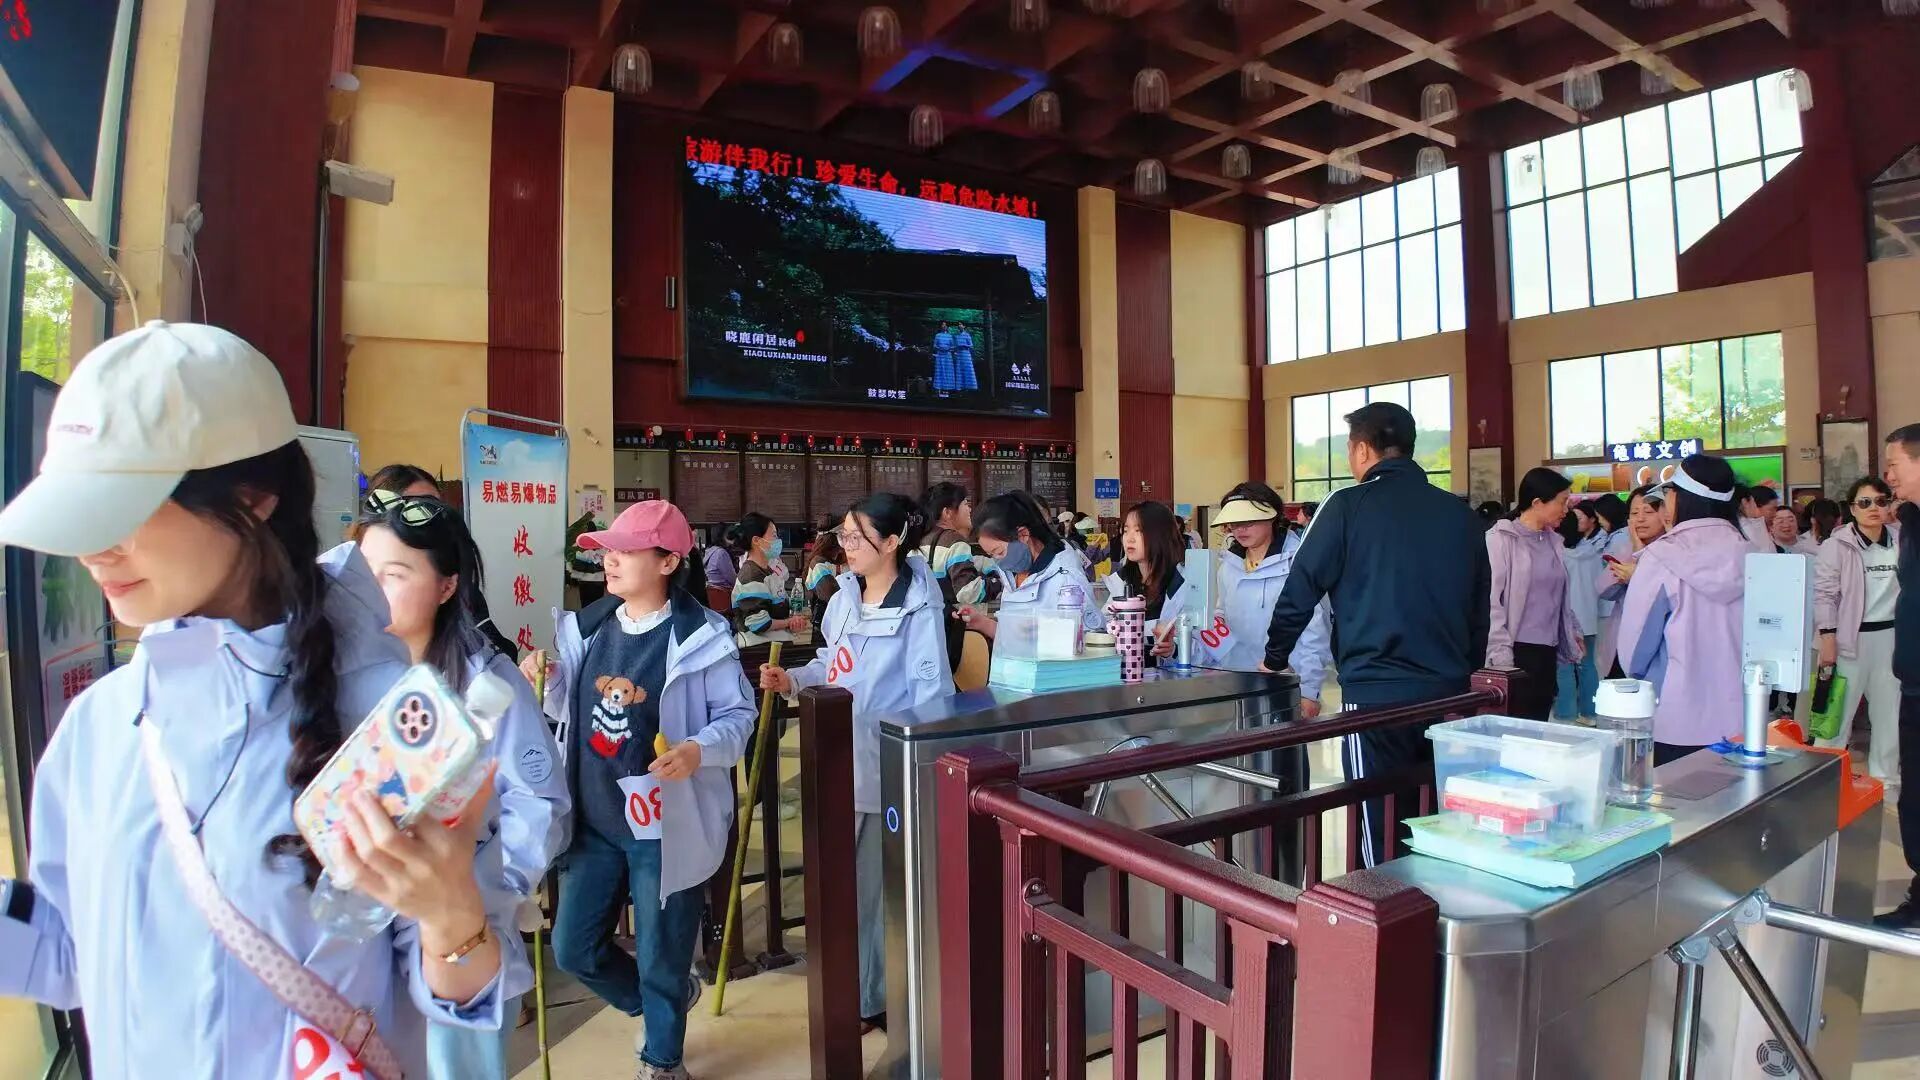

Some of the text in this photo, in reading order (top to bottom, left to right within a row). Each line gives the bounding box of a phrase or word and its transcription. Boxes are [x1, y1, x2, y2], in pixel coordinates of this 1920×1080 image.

[482, 480, 557, 505] 易燃易爆物品
